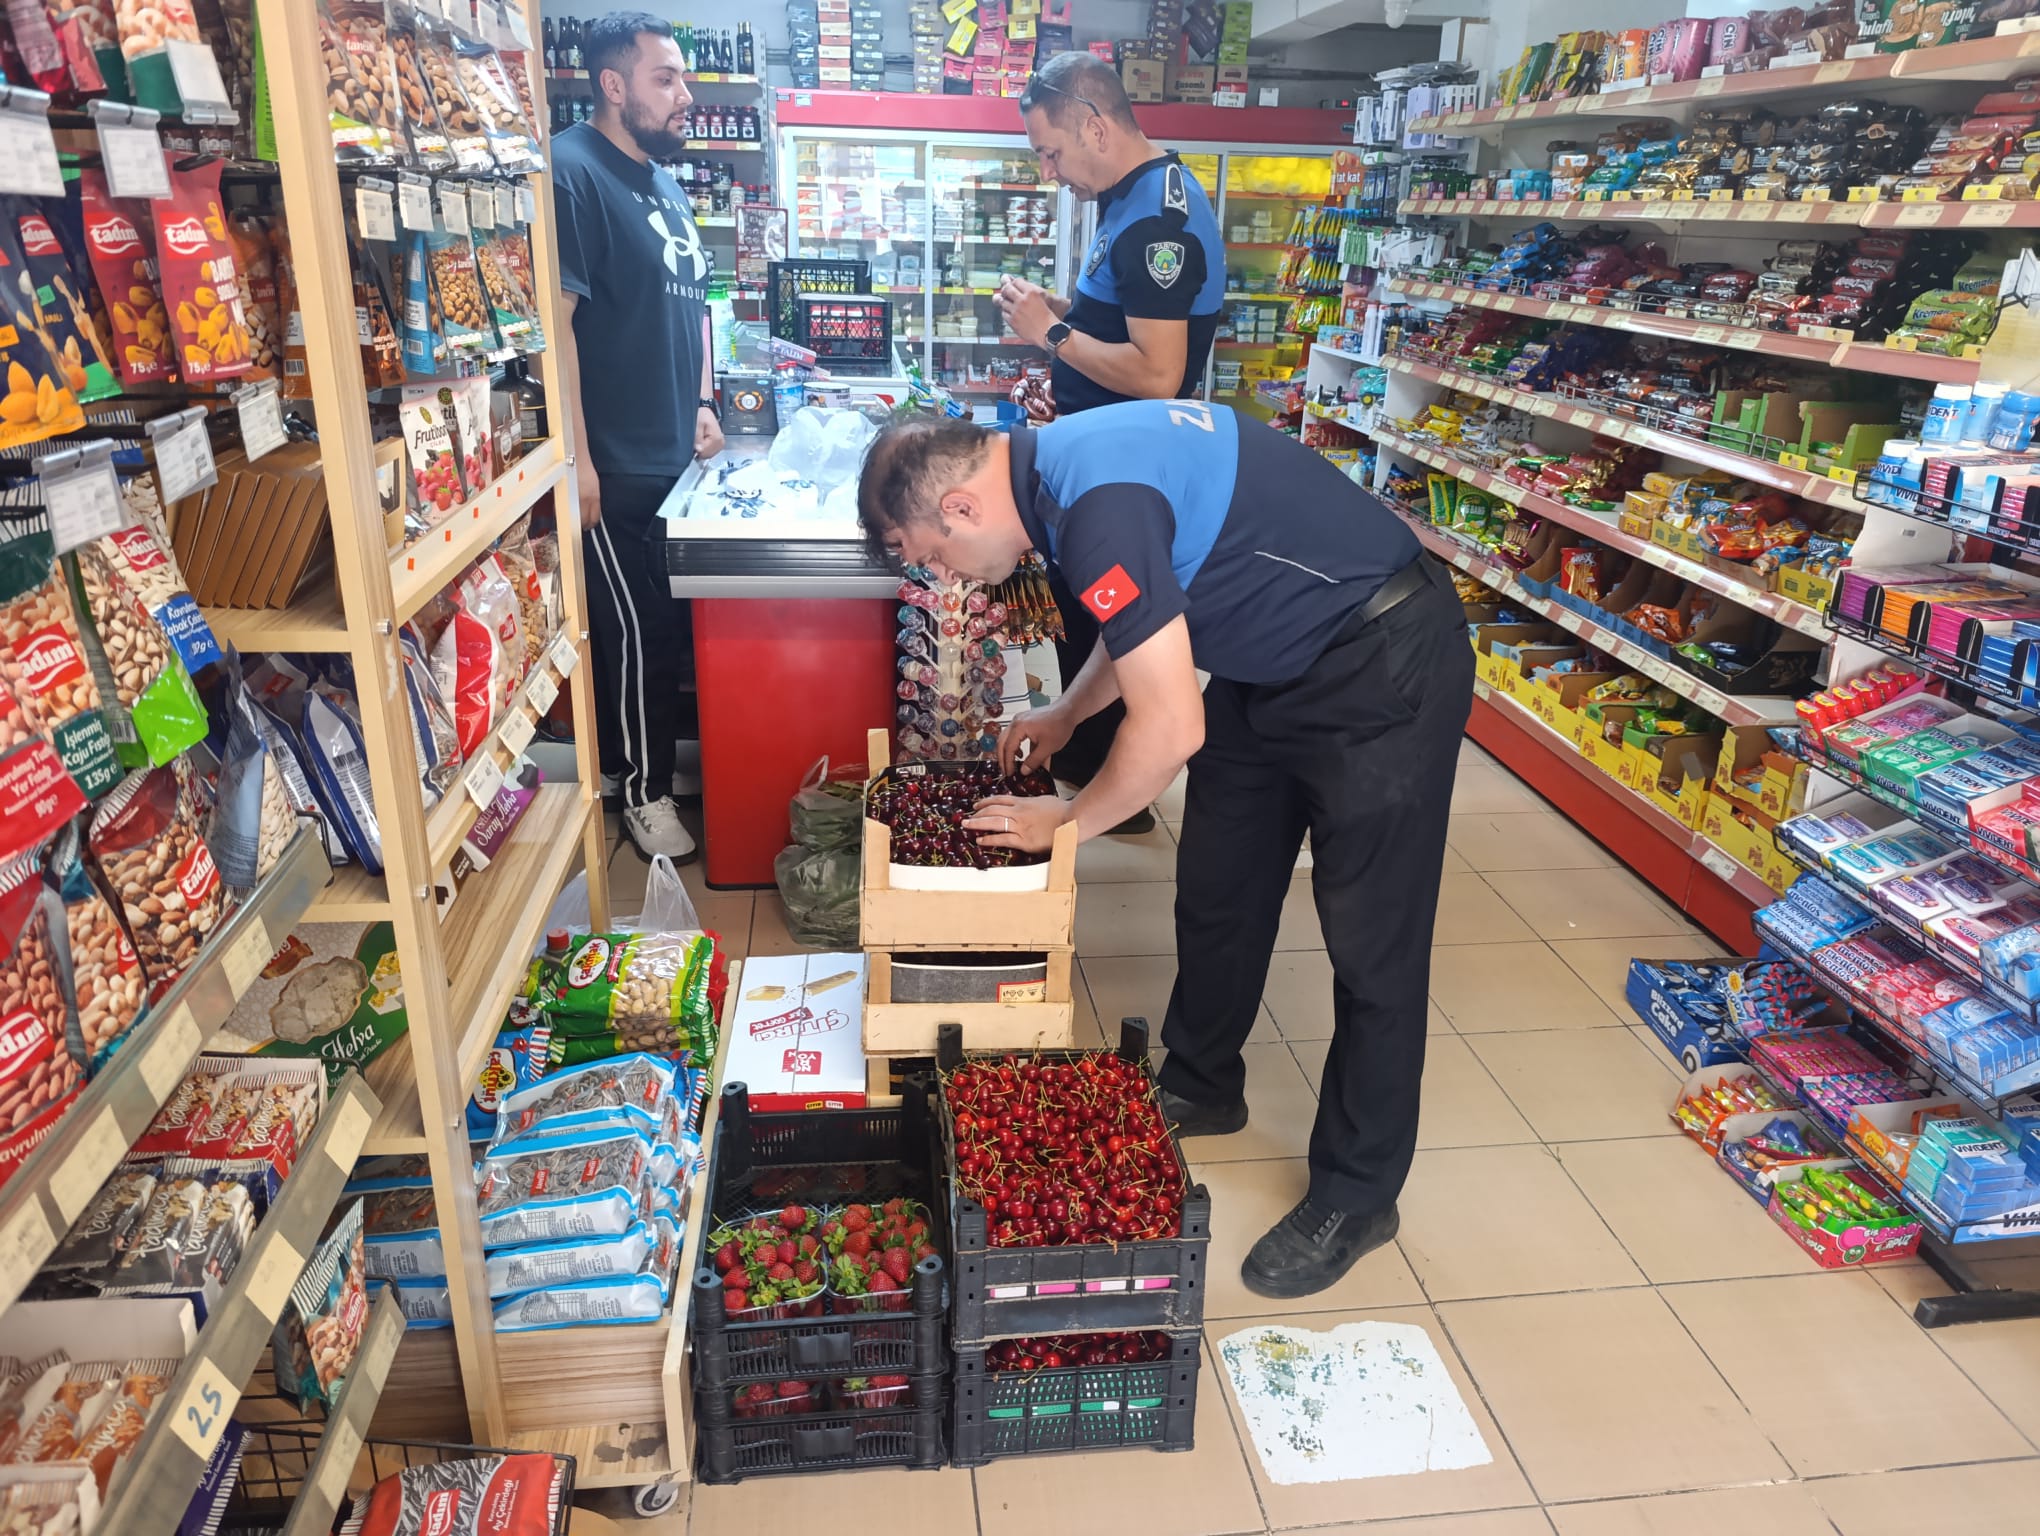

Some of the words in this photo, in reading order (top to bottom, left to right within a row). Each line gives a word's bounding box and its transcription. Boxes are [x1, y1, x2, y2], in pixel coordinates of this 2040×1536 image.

[90, 224, 139, 243] tadım
[1841, 847, 1870, 868] mentos
[1789, 889, 1821, 918] mentos
[1894, 878, 1928, 901] mentos
[1815, 953, 1854, 983] mentos
[1825, 948, 1862, 978] mentos
[1650, 988, 1684, 1031] Blizzard
[1650, 1001, 1678, 1038] Cake
[1952, 1141, 2005, 1153] VIVIDENT
[187, 1383, 222, 1438] 25
